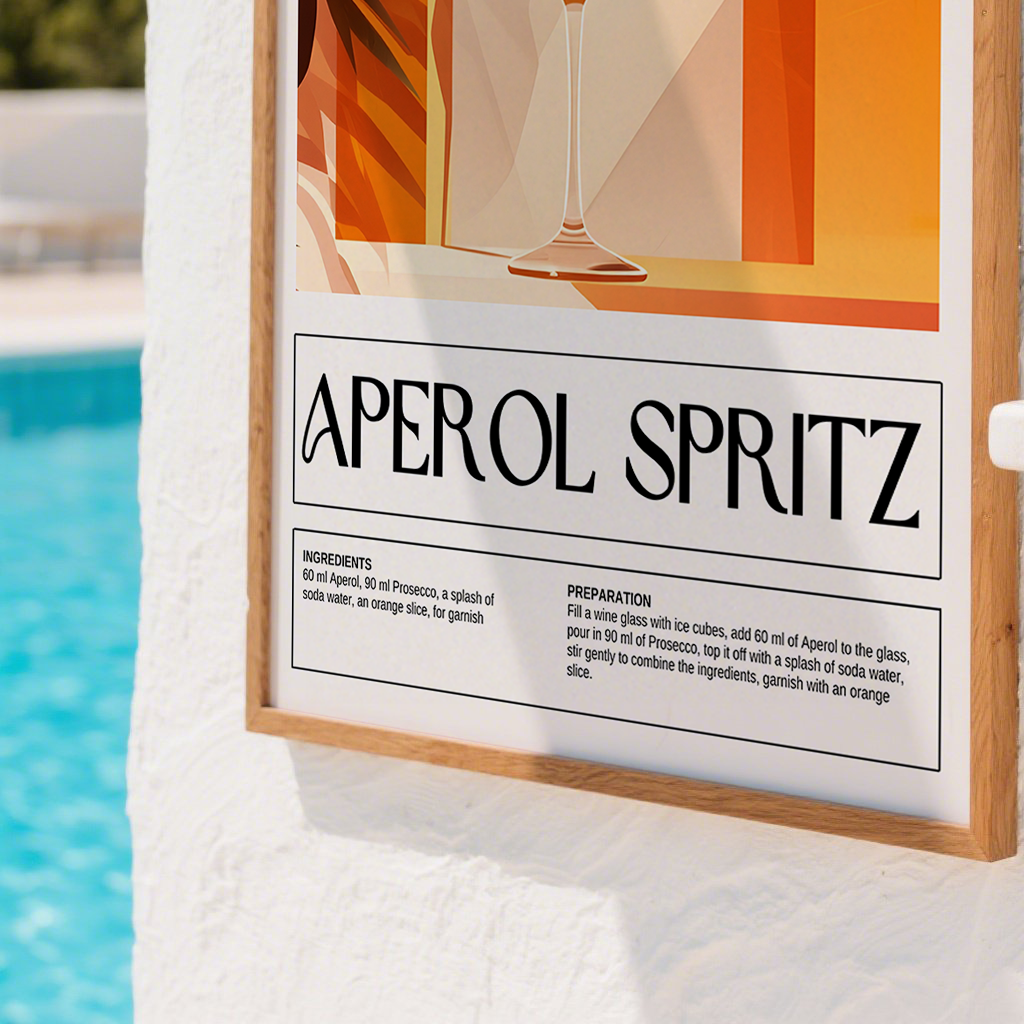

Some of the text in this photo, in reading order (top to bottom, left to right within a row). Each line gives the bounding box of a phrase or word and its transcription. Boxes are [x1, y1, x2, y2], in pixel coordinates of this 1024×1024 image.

[301, 372, 922, 529] APEROL SPRITZ
[302, 549, 372, 571] INGREDIENTS
[302, 567, 495, 607] 60 ml Aperol, 90 ml Prosecco, a splash of
[302, 588, 484, 625] soda water, an orange slice, for garnish
[567, 584, 651, 608] PREPARATION
[567, 603, 910, 666] Fill a wine glass with ice cubes, add 60 ml of Aperol to the glass,
[566, 625, 904, 686] pour in 90 ml of Prosecco, top it off with a splash of soda water,
[566, 663, 593, 680] slice.
[566, 643, 891, 706] stir gently to combine the ingredients, garnish with an orange
